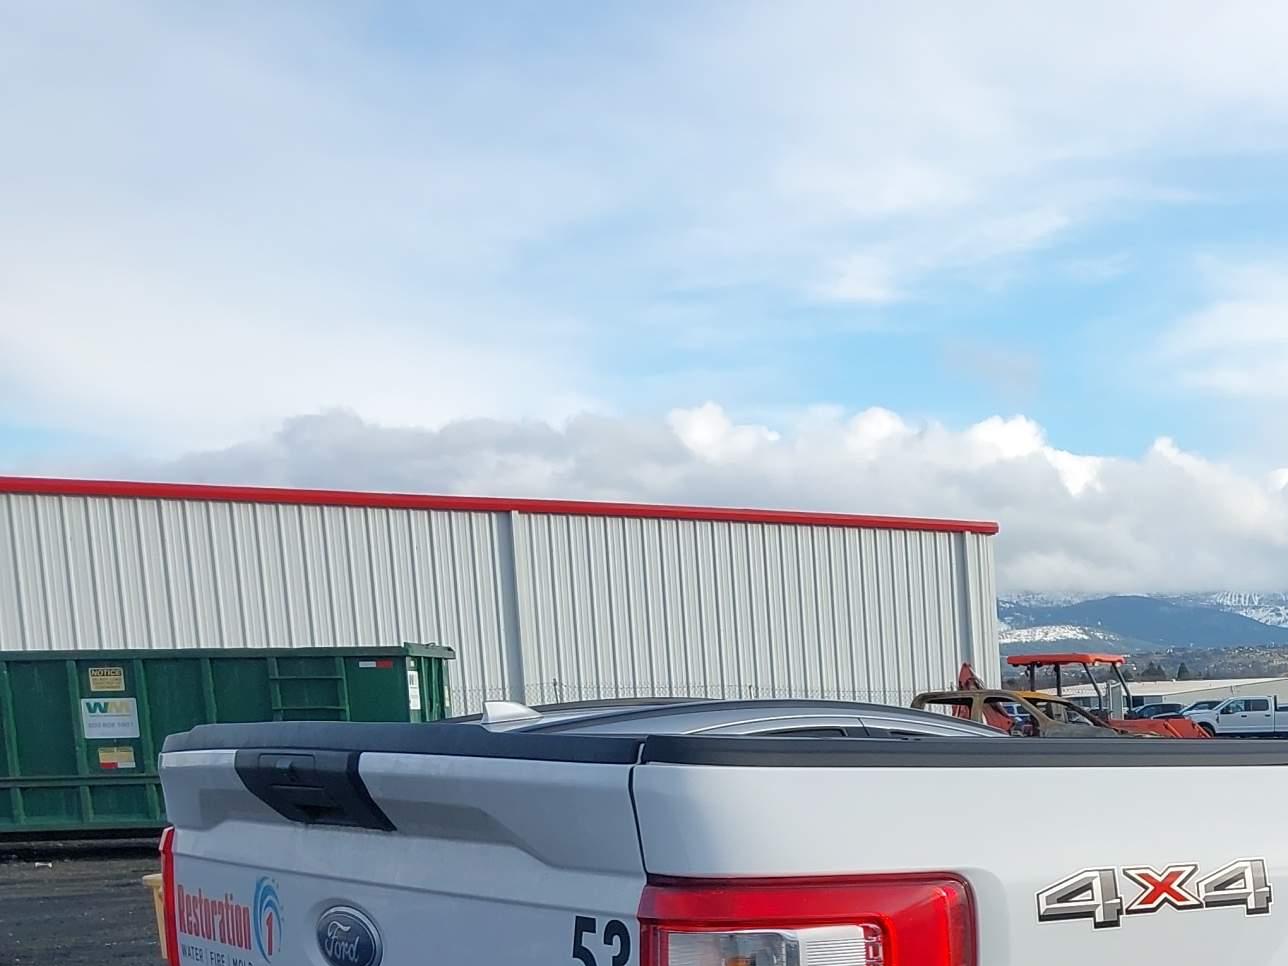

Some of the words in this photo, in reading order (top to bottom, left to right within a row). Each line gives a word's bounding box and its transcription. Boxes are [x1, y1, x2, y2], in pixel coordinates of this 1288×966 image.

[91, 669, 121, 677] NOTICE
[177, 885, 251, 951] Restoration
[181, 944, 204, 962] WATER
[325, 921, 360, 962] Ford
